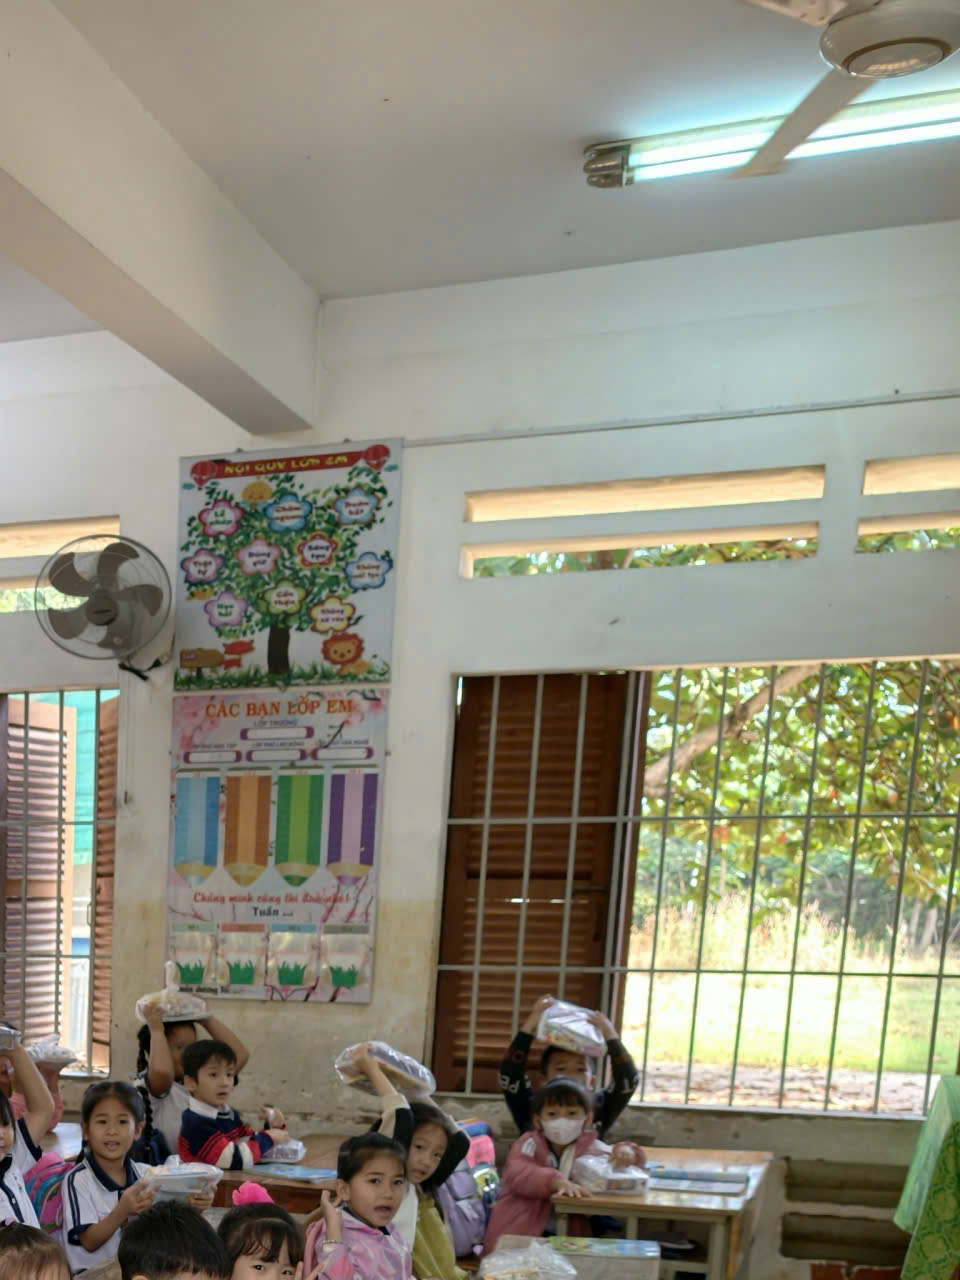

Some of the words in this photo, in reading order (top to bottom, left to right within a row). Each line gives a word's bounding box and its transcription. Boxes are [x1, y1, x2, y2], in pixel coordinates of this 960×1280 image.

[205, 699, 240, 718] CÁC
[246, 701, 281, 719] BẠN
[326, 699, 354, 714] EM
[252, 905, 280, 917] Tuần
